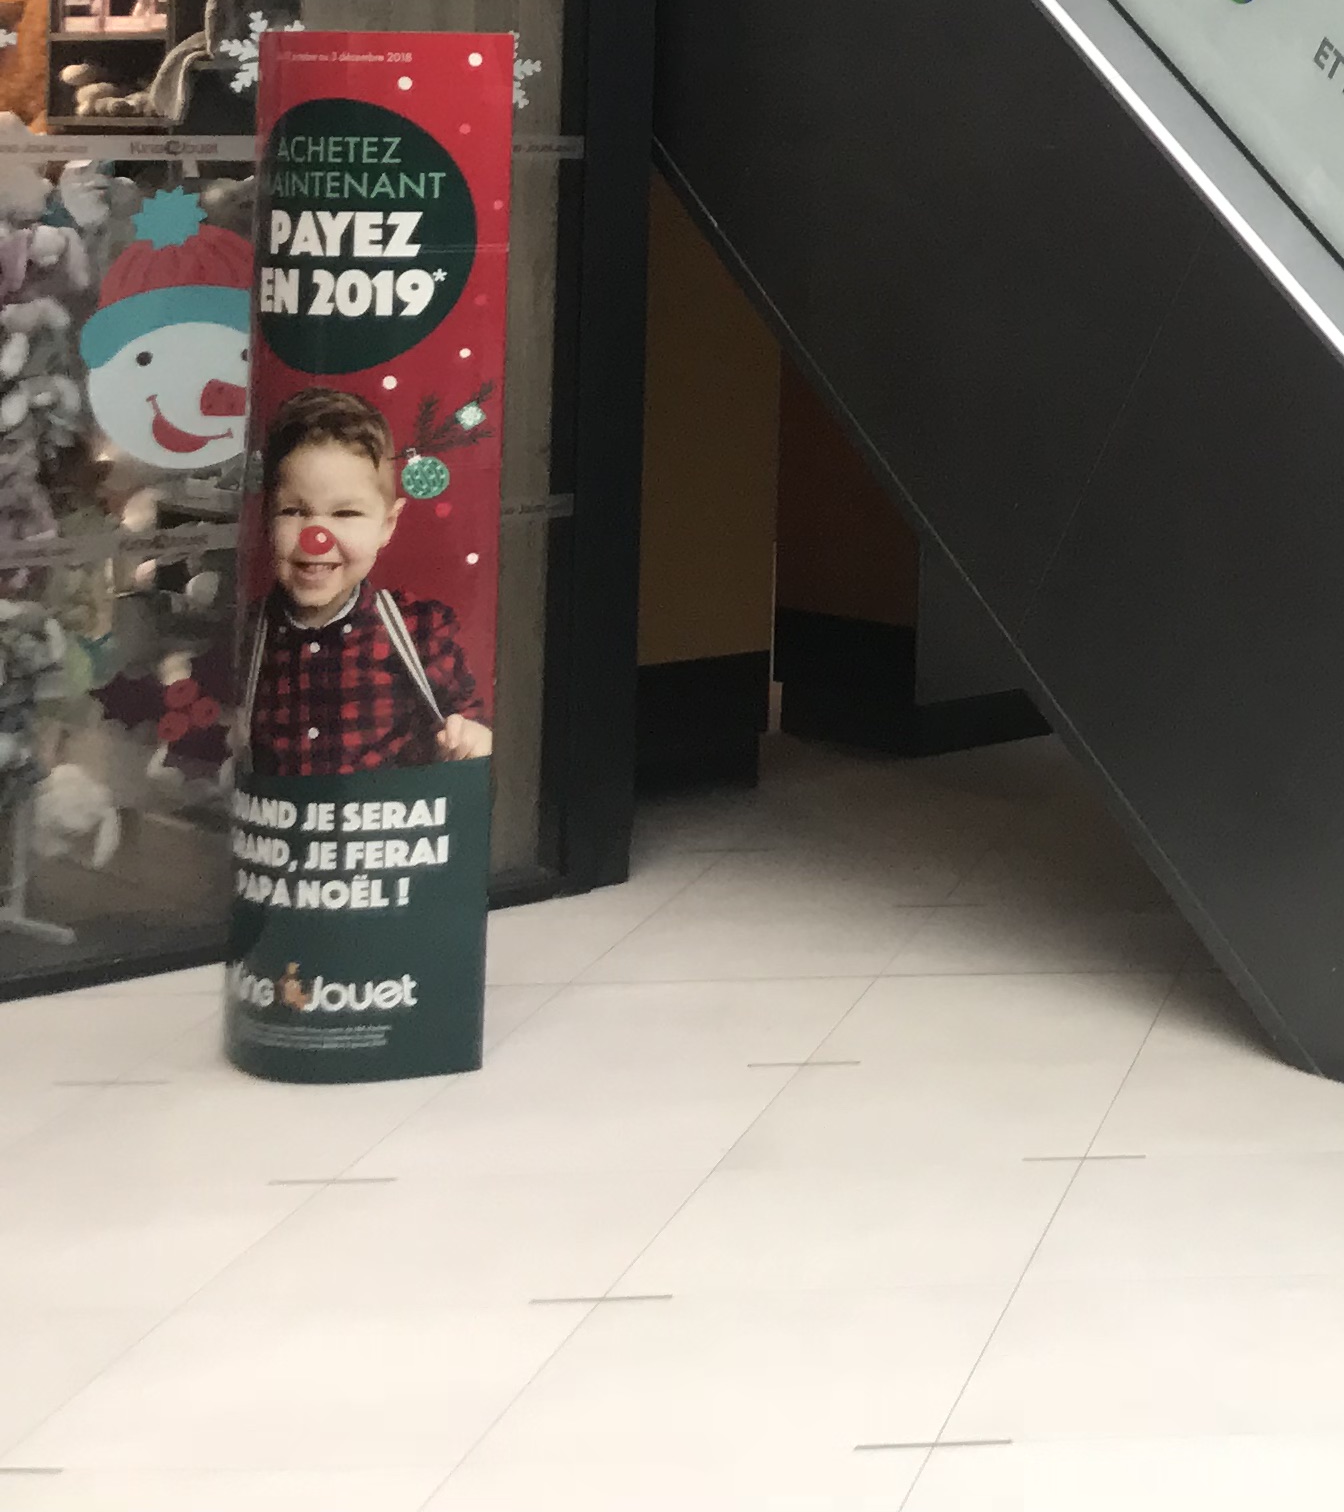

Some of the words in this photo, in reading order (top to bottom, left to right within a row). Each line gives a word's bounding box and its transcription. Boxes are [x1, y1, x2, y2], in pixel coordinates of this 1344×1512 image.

[277, 136, 402, 164] ACHETEZ
[270, 209, 423, 257] PAYEZ
[260, 266, 300, 315] EN
[232, 788, 297, 829] UAND
[302, 802, 335, 832] JE
[342, 797, 447, 832] SERAI
[232, 826, 299, 873] RAND,
[305, 841, 337, 871] JE
[345, 834, 449, 870] FERAI
[295, 874, 389, 910] NOËL
